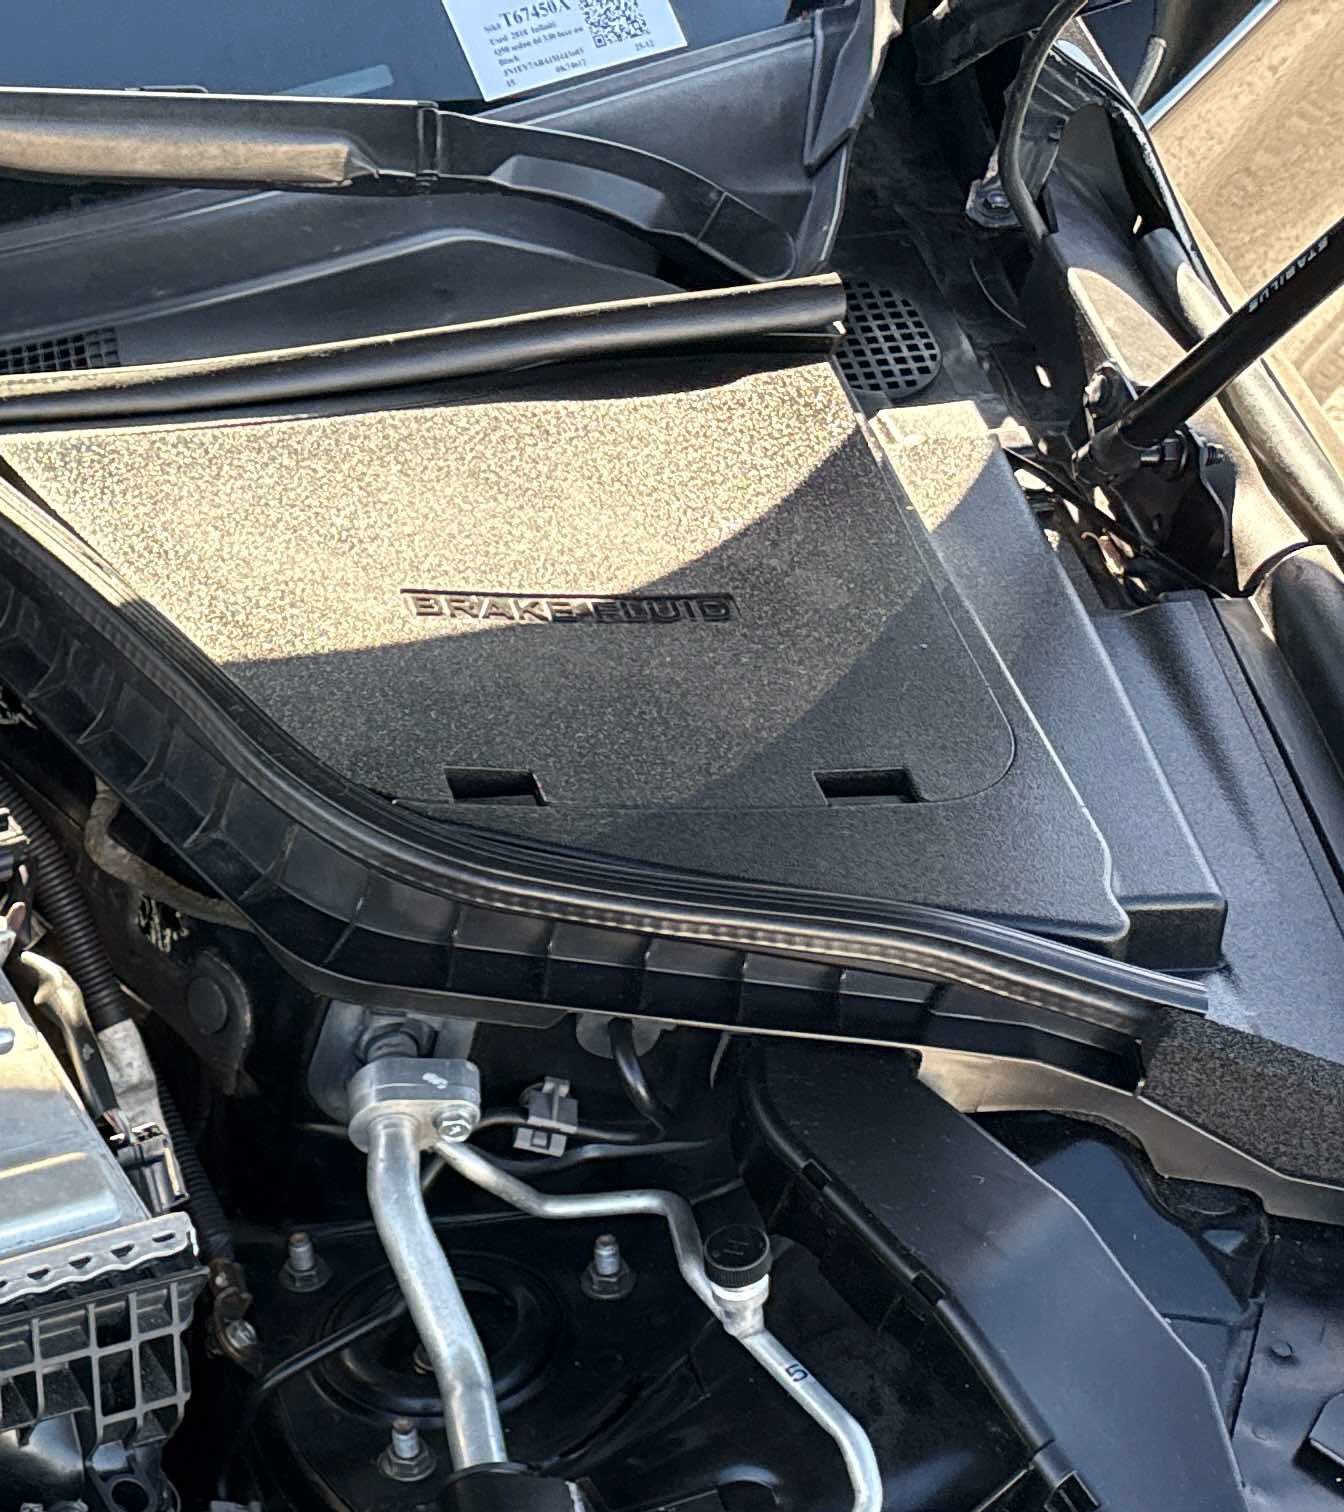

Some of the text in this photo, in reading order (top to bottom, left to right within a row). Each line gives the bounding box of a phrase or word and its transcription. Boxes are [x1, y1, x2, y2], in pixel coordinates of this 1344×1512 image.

[411, 596, 736, 624] BRAKE FLUID
[785, 1363, 808, 1382] 5
